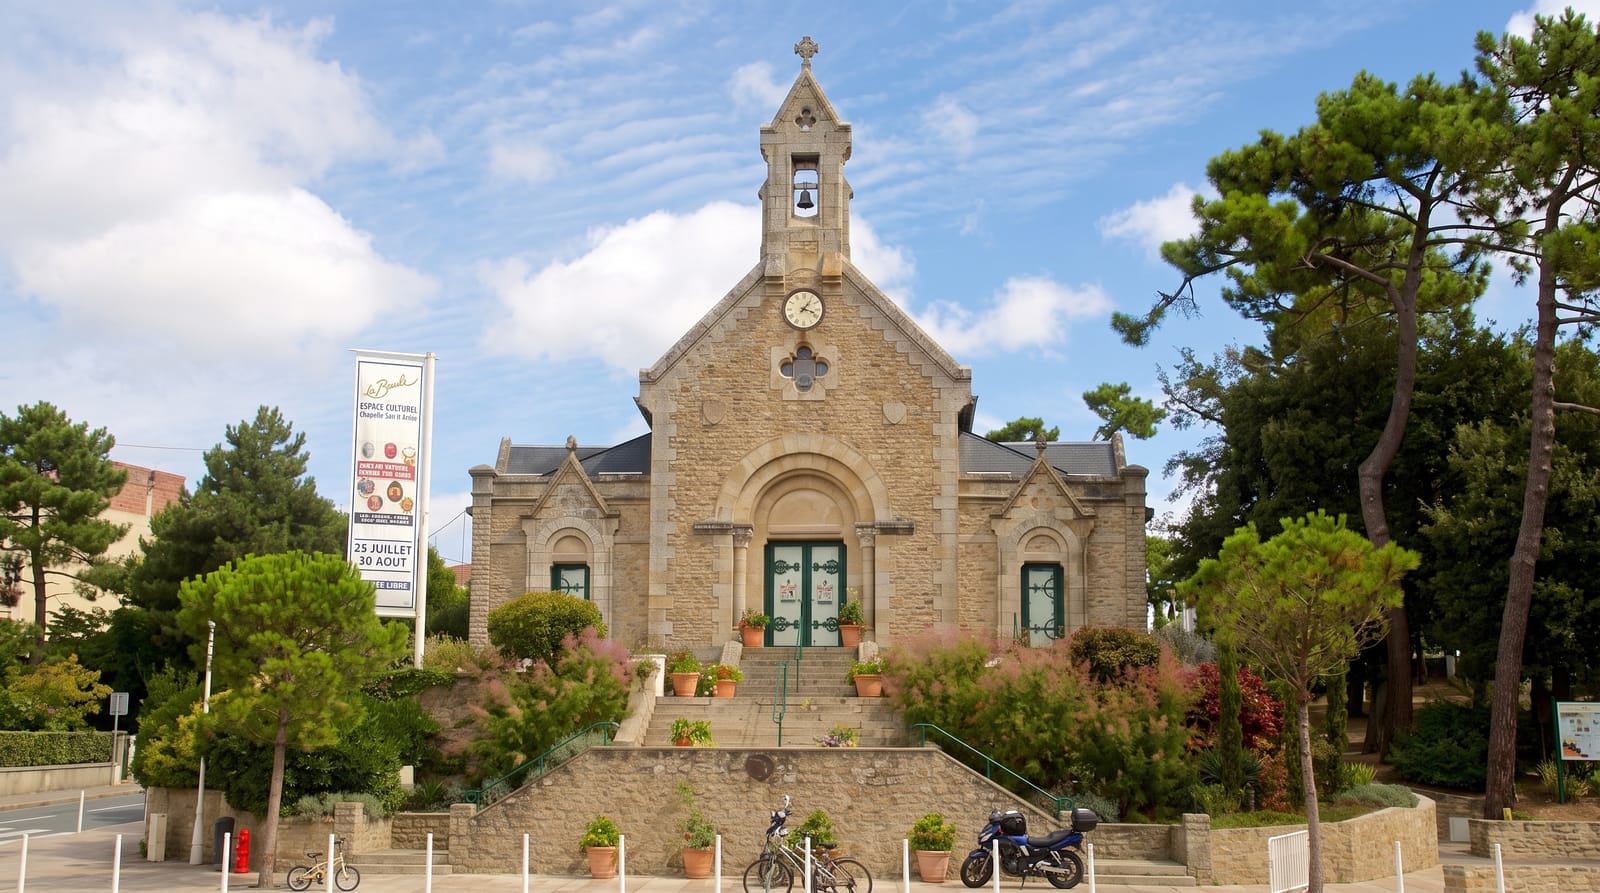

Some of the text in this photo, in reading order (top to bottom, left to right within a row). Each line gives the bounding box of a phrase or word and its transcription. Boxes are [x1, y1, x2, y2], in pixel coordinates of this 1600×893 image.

[360, 402, 418, 414] ESPACE CULTUREL
[360, 411, 384, 420] Chapelle
[354, 543, 412, 555] 25 JUILLET
[359, 556, 407, 567] 30 AOUT
[386, 581, 408, 590] LIBRE
